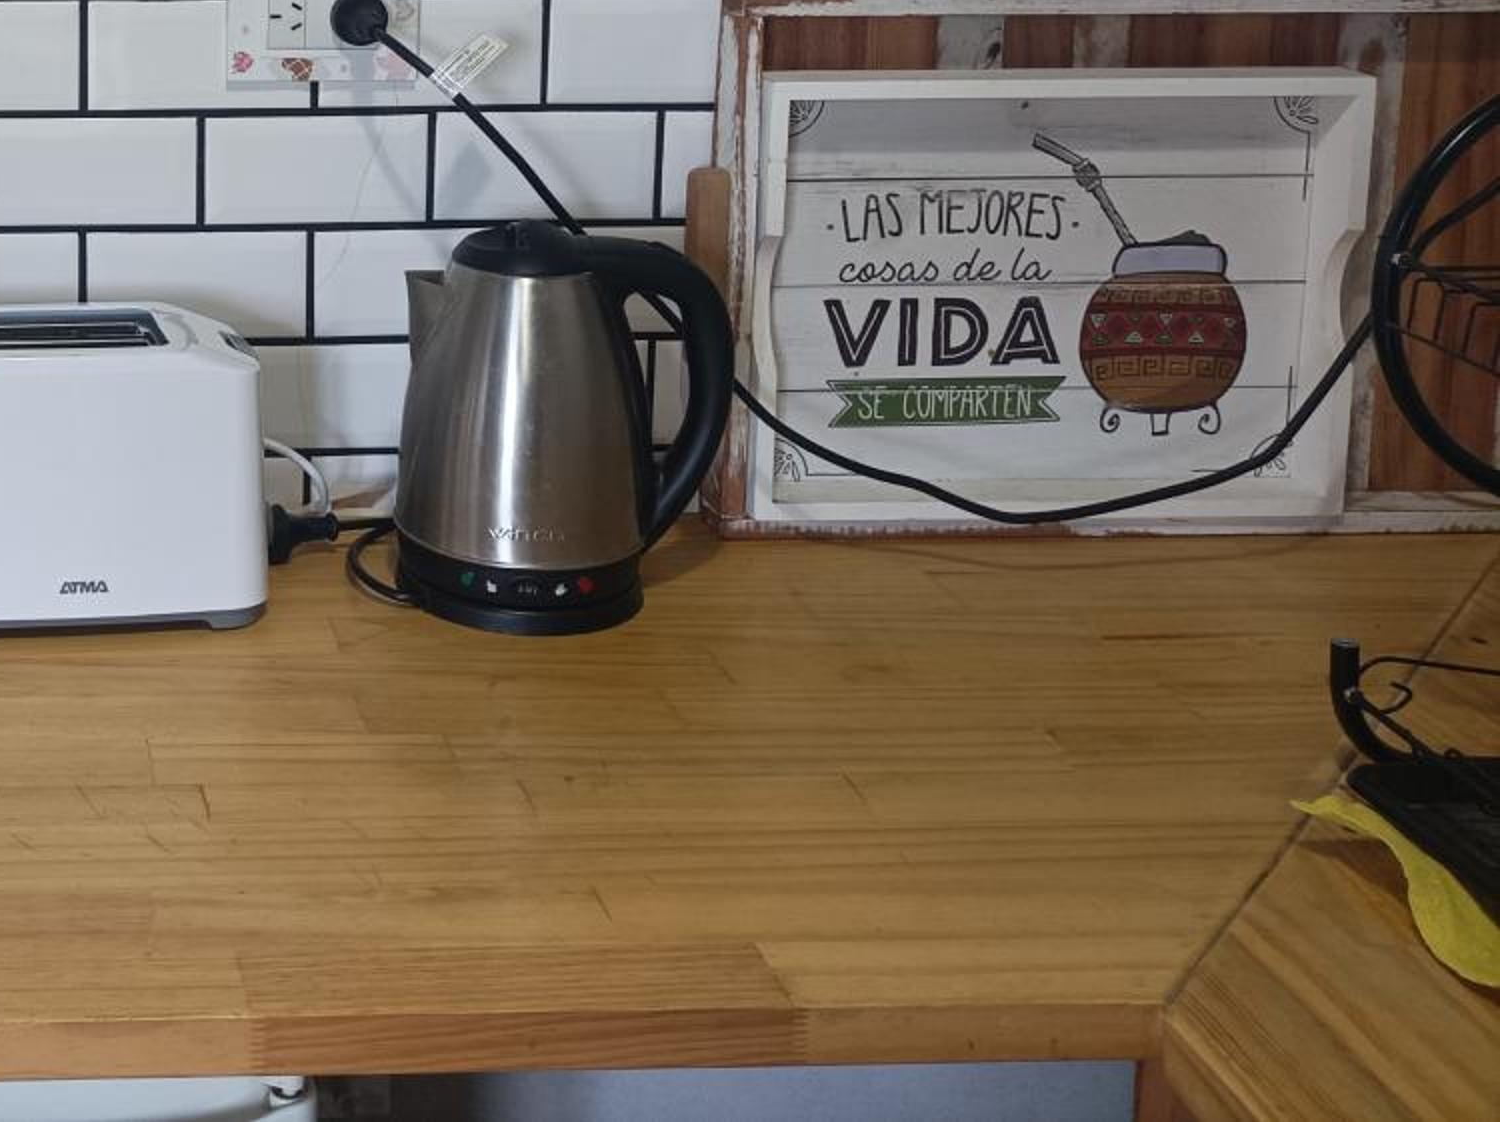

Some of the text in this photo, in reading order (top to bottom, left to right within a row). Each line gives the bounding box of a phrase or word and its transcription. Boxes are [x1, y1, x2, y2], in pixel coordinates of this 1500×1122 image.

[841, 188, 1066, 242] LAS MEJORES
[839, 247, 1052, 283] cosas de la
[824, 296, 1060, 367] VIDA
[857, 384, 1032, 419] SE COMPARTEN
[59, 580, 109, 595] ATMA
